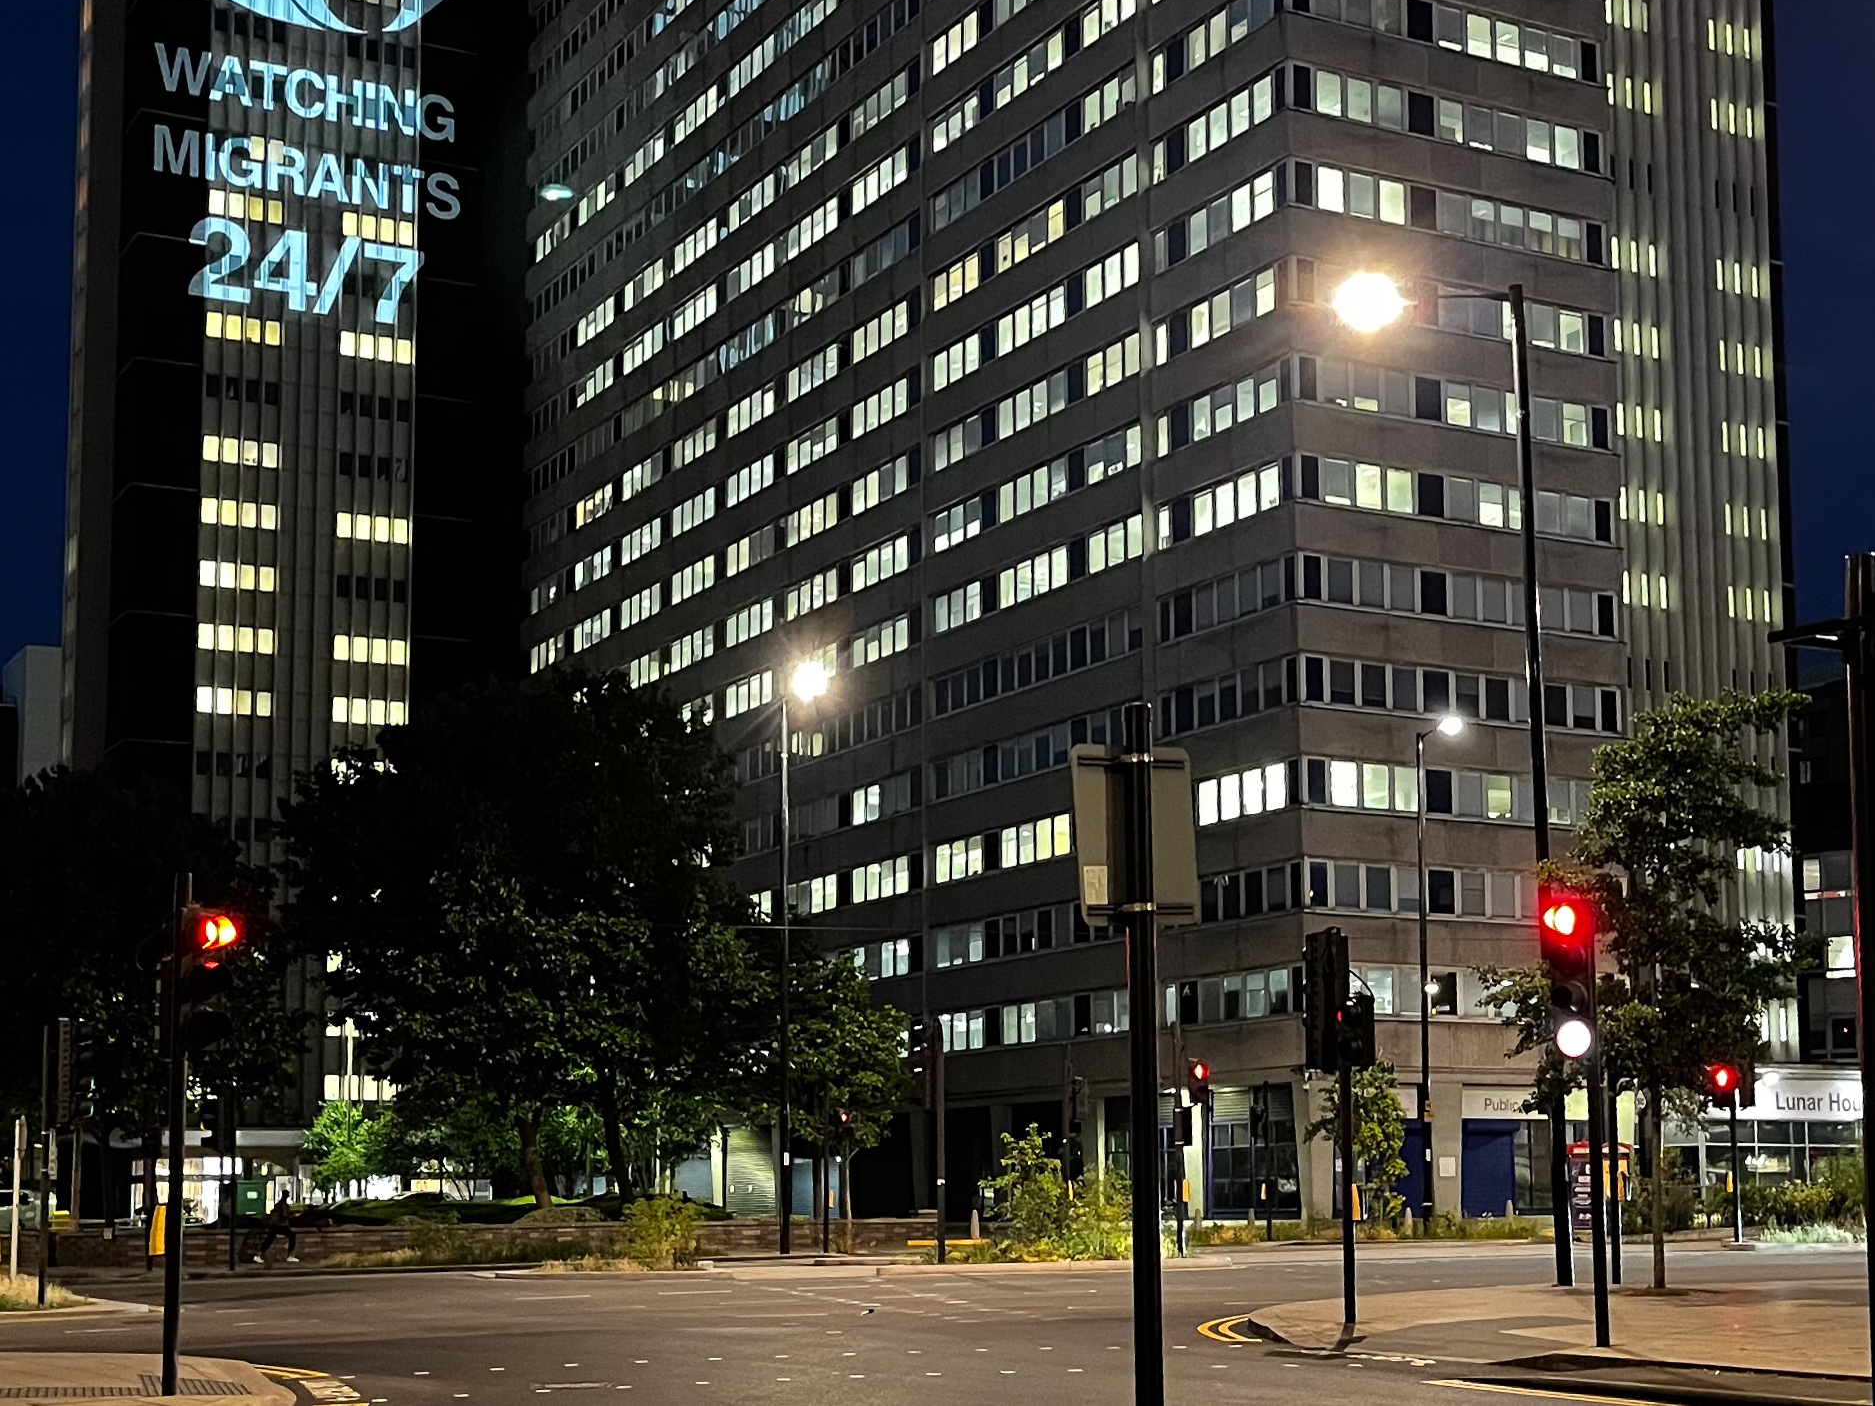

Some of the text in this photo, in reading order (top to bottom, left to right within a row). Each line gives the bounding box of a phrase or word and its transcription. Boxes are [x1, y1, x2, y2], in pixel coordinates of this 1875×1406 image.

[154, 42, 456, 143] WATCHING
[153, 124, 461, 220] MIGRANTS
[187, 216, 425, 324] 24/7
[1775, 1091, 1823, 1111] Lunar
